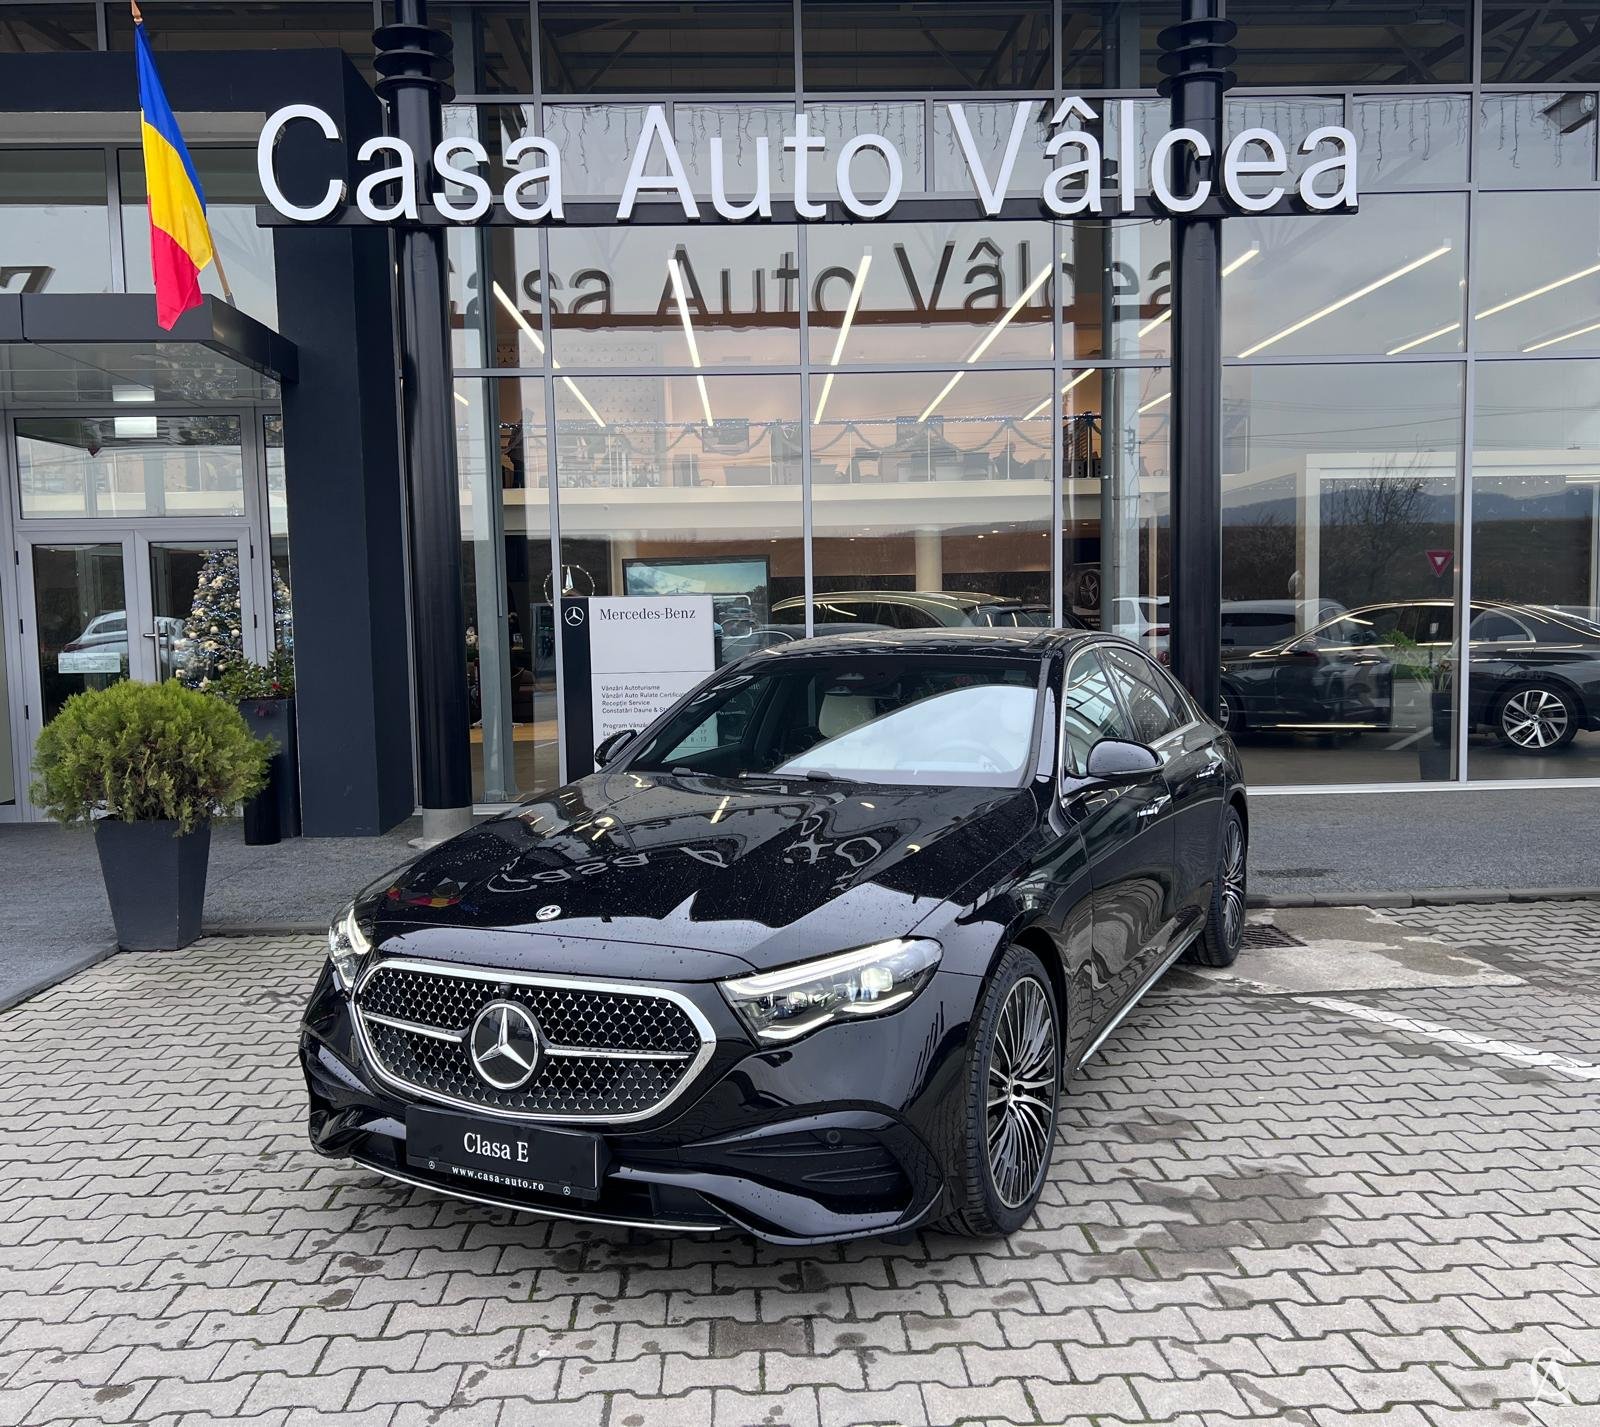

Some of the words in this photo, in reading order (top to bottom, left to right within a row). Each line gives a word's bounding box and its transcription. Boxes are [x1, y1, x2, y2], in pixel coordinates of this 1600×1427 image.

[257, 103, 566, 221] Casa
[617, 104, 903, 220] Auto
[946, 96, 1358, 217] Vâlcea
[600, 607, 696, 620] Mercedes-Benz
[463, 1132, 512, 1160] Clasa
[516, 1141, 529, 1162] E
[451, 1166, 545, 1191] www.casa-auto.ro
